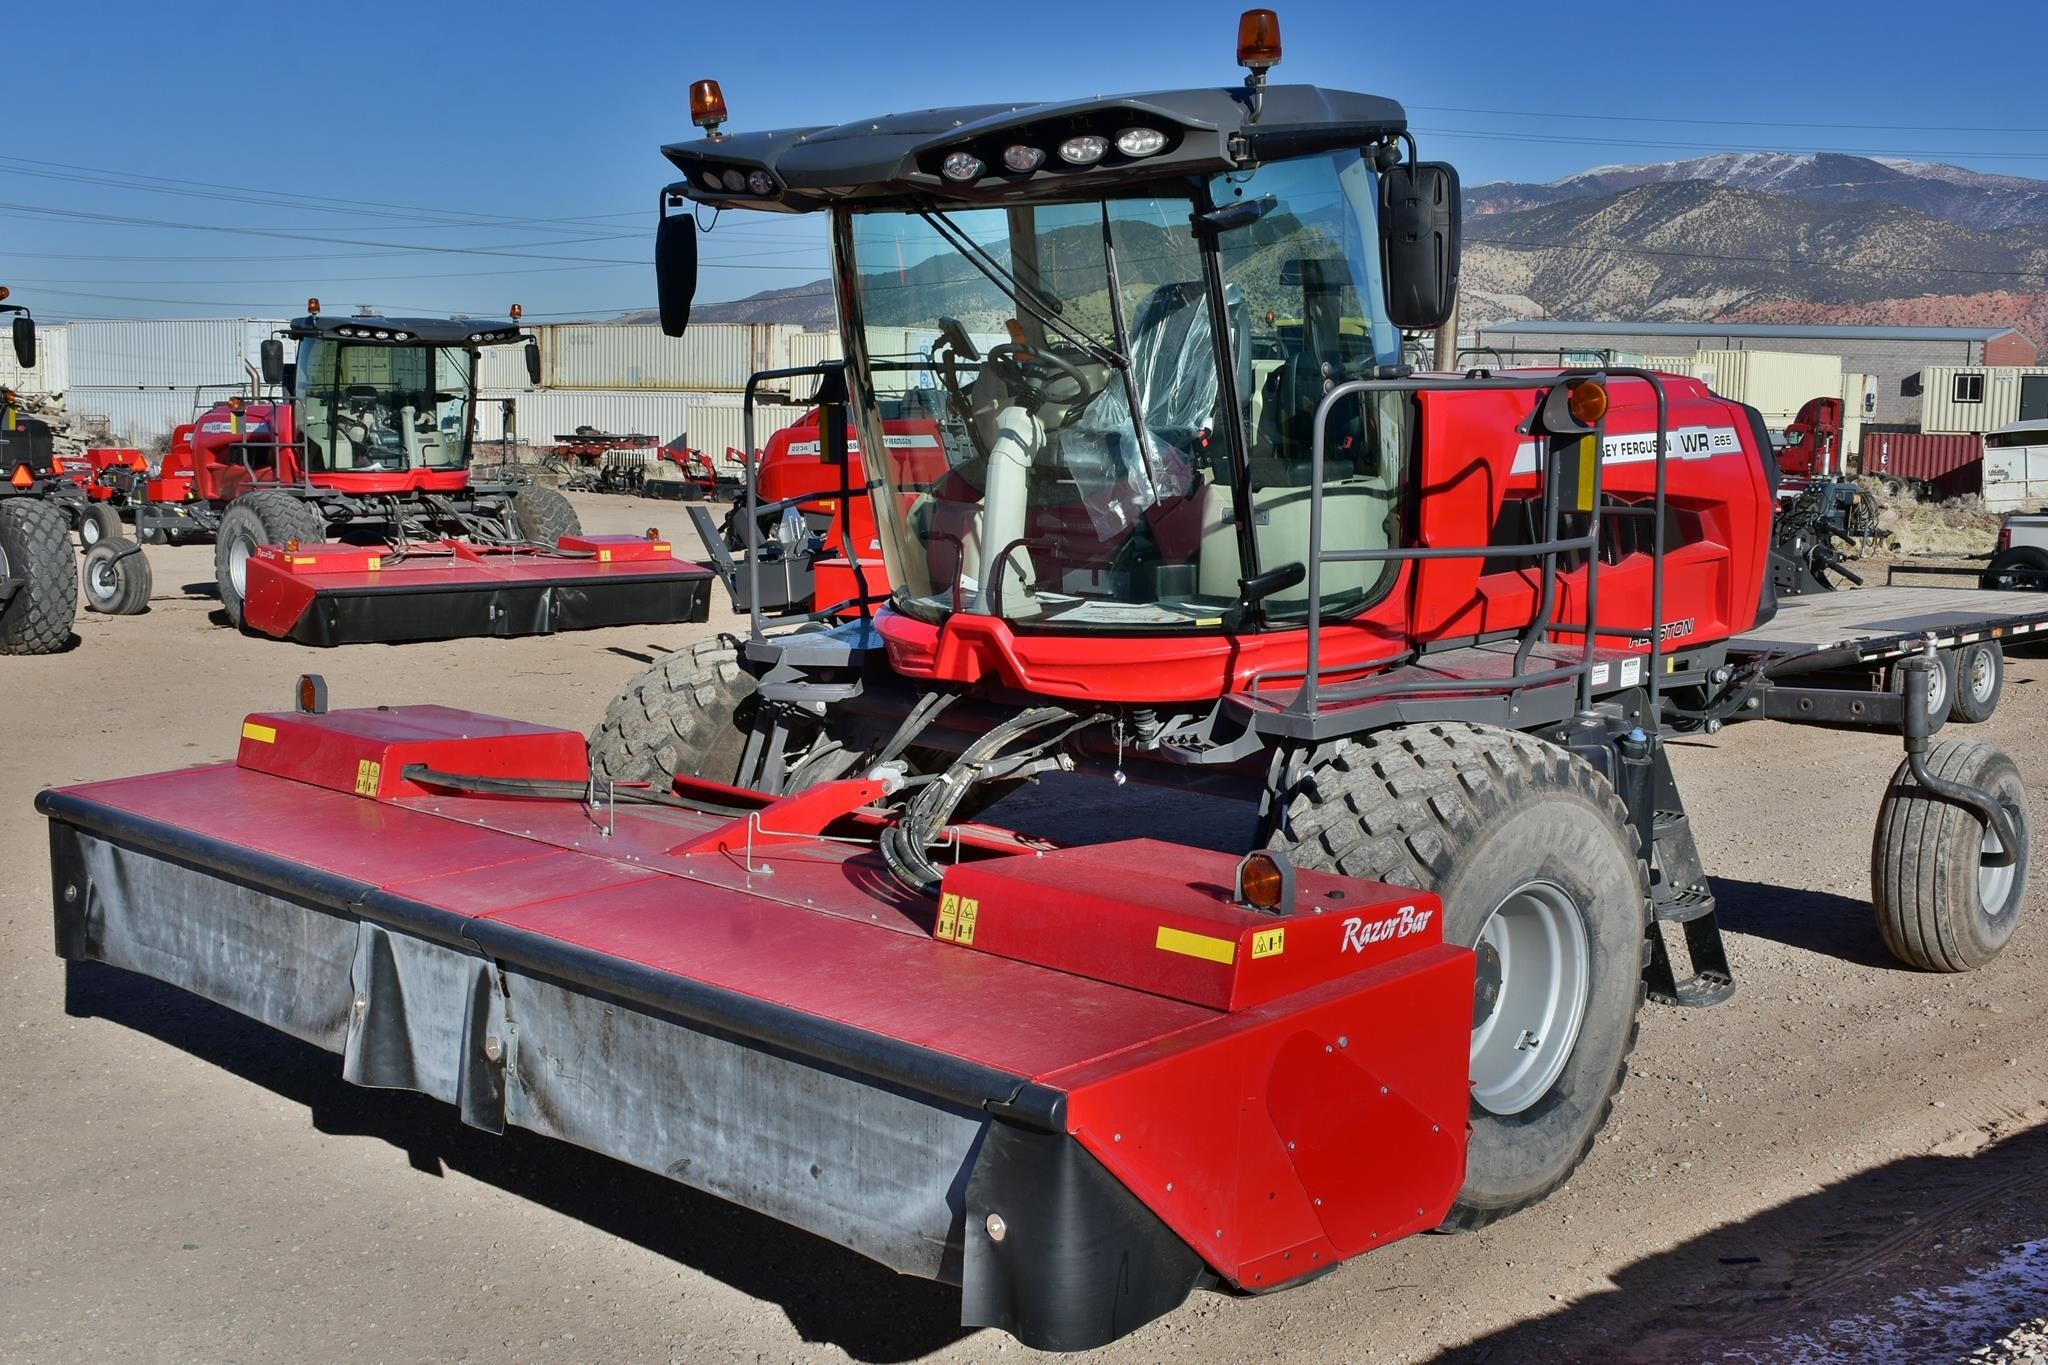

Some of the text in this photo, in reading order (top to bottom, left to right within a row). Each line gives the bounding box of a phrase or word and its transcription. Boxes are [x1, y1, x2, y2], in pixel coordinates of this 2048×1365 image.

[1621, 439, 1672, 456] FERGUSN
[1680, 433, 1709, 453] WR
[1713, 435, 1732, 446] 265
[1629, 618, 1694, 648] HSTON
[1341, 905, 1433, 954] RazorBar
